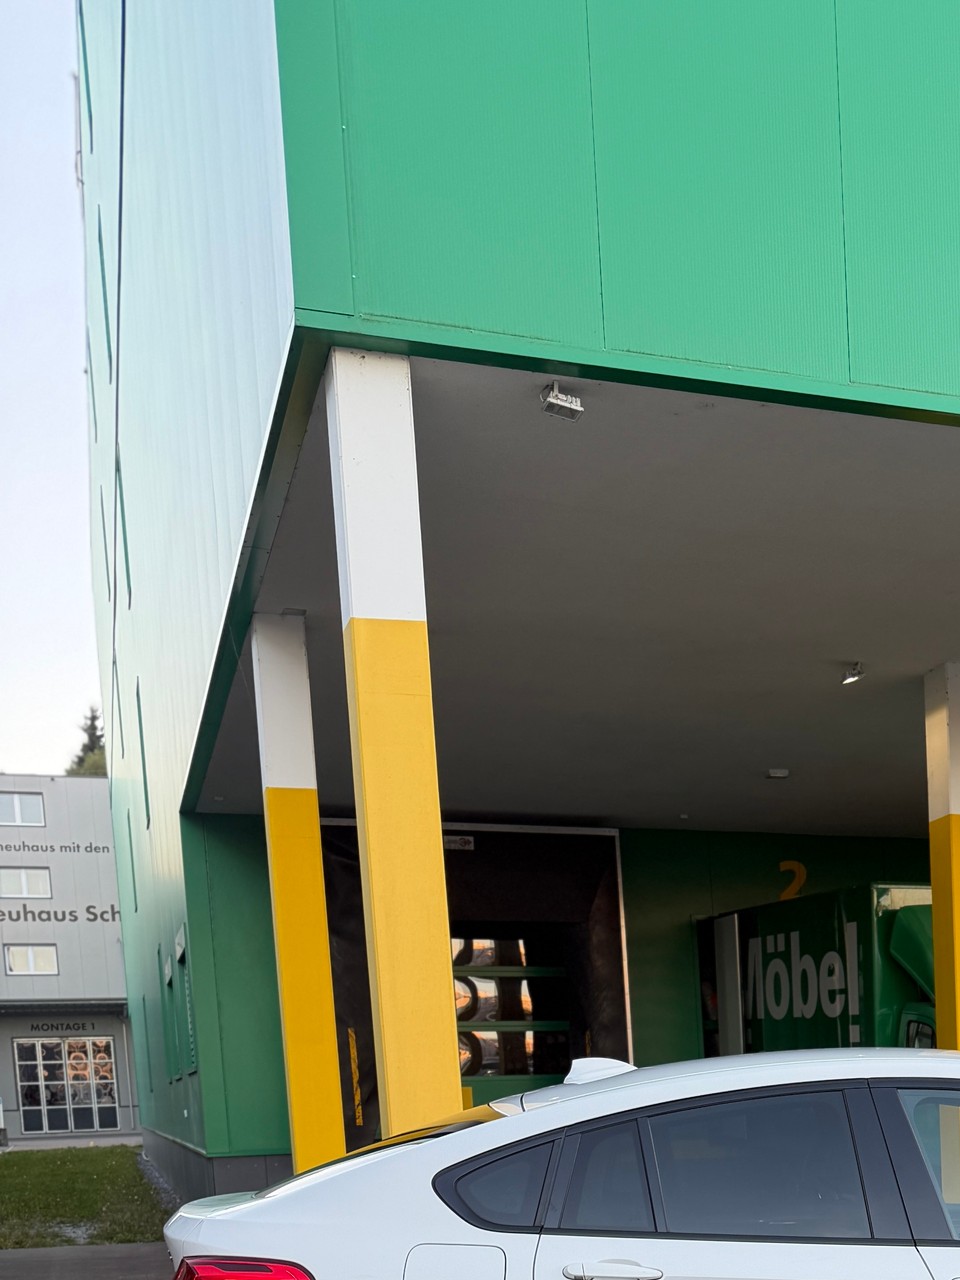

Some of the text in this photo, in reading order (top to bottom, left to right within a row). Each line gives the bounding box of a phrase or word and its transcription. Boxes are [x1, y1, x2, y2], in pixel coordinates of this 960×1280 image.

[60, 842, 81, 853] mit
[85, 842, 110, 853] den
[779, 860, 807, 900] 2
[30, 1022, 95, 1032] MONTAGE 1
